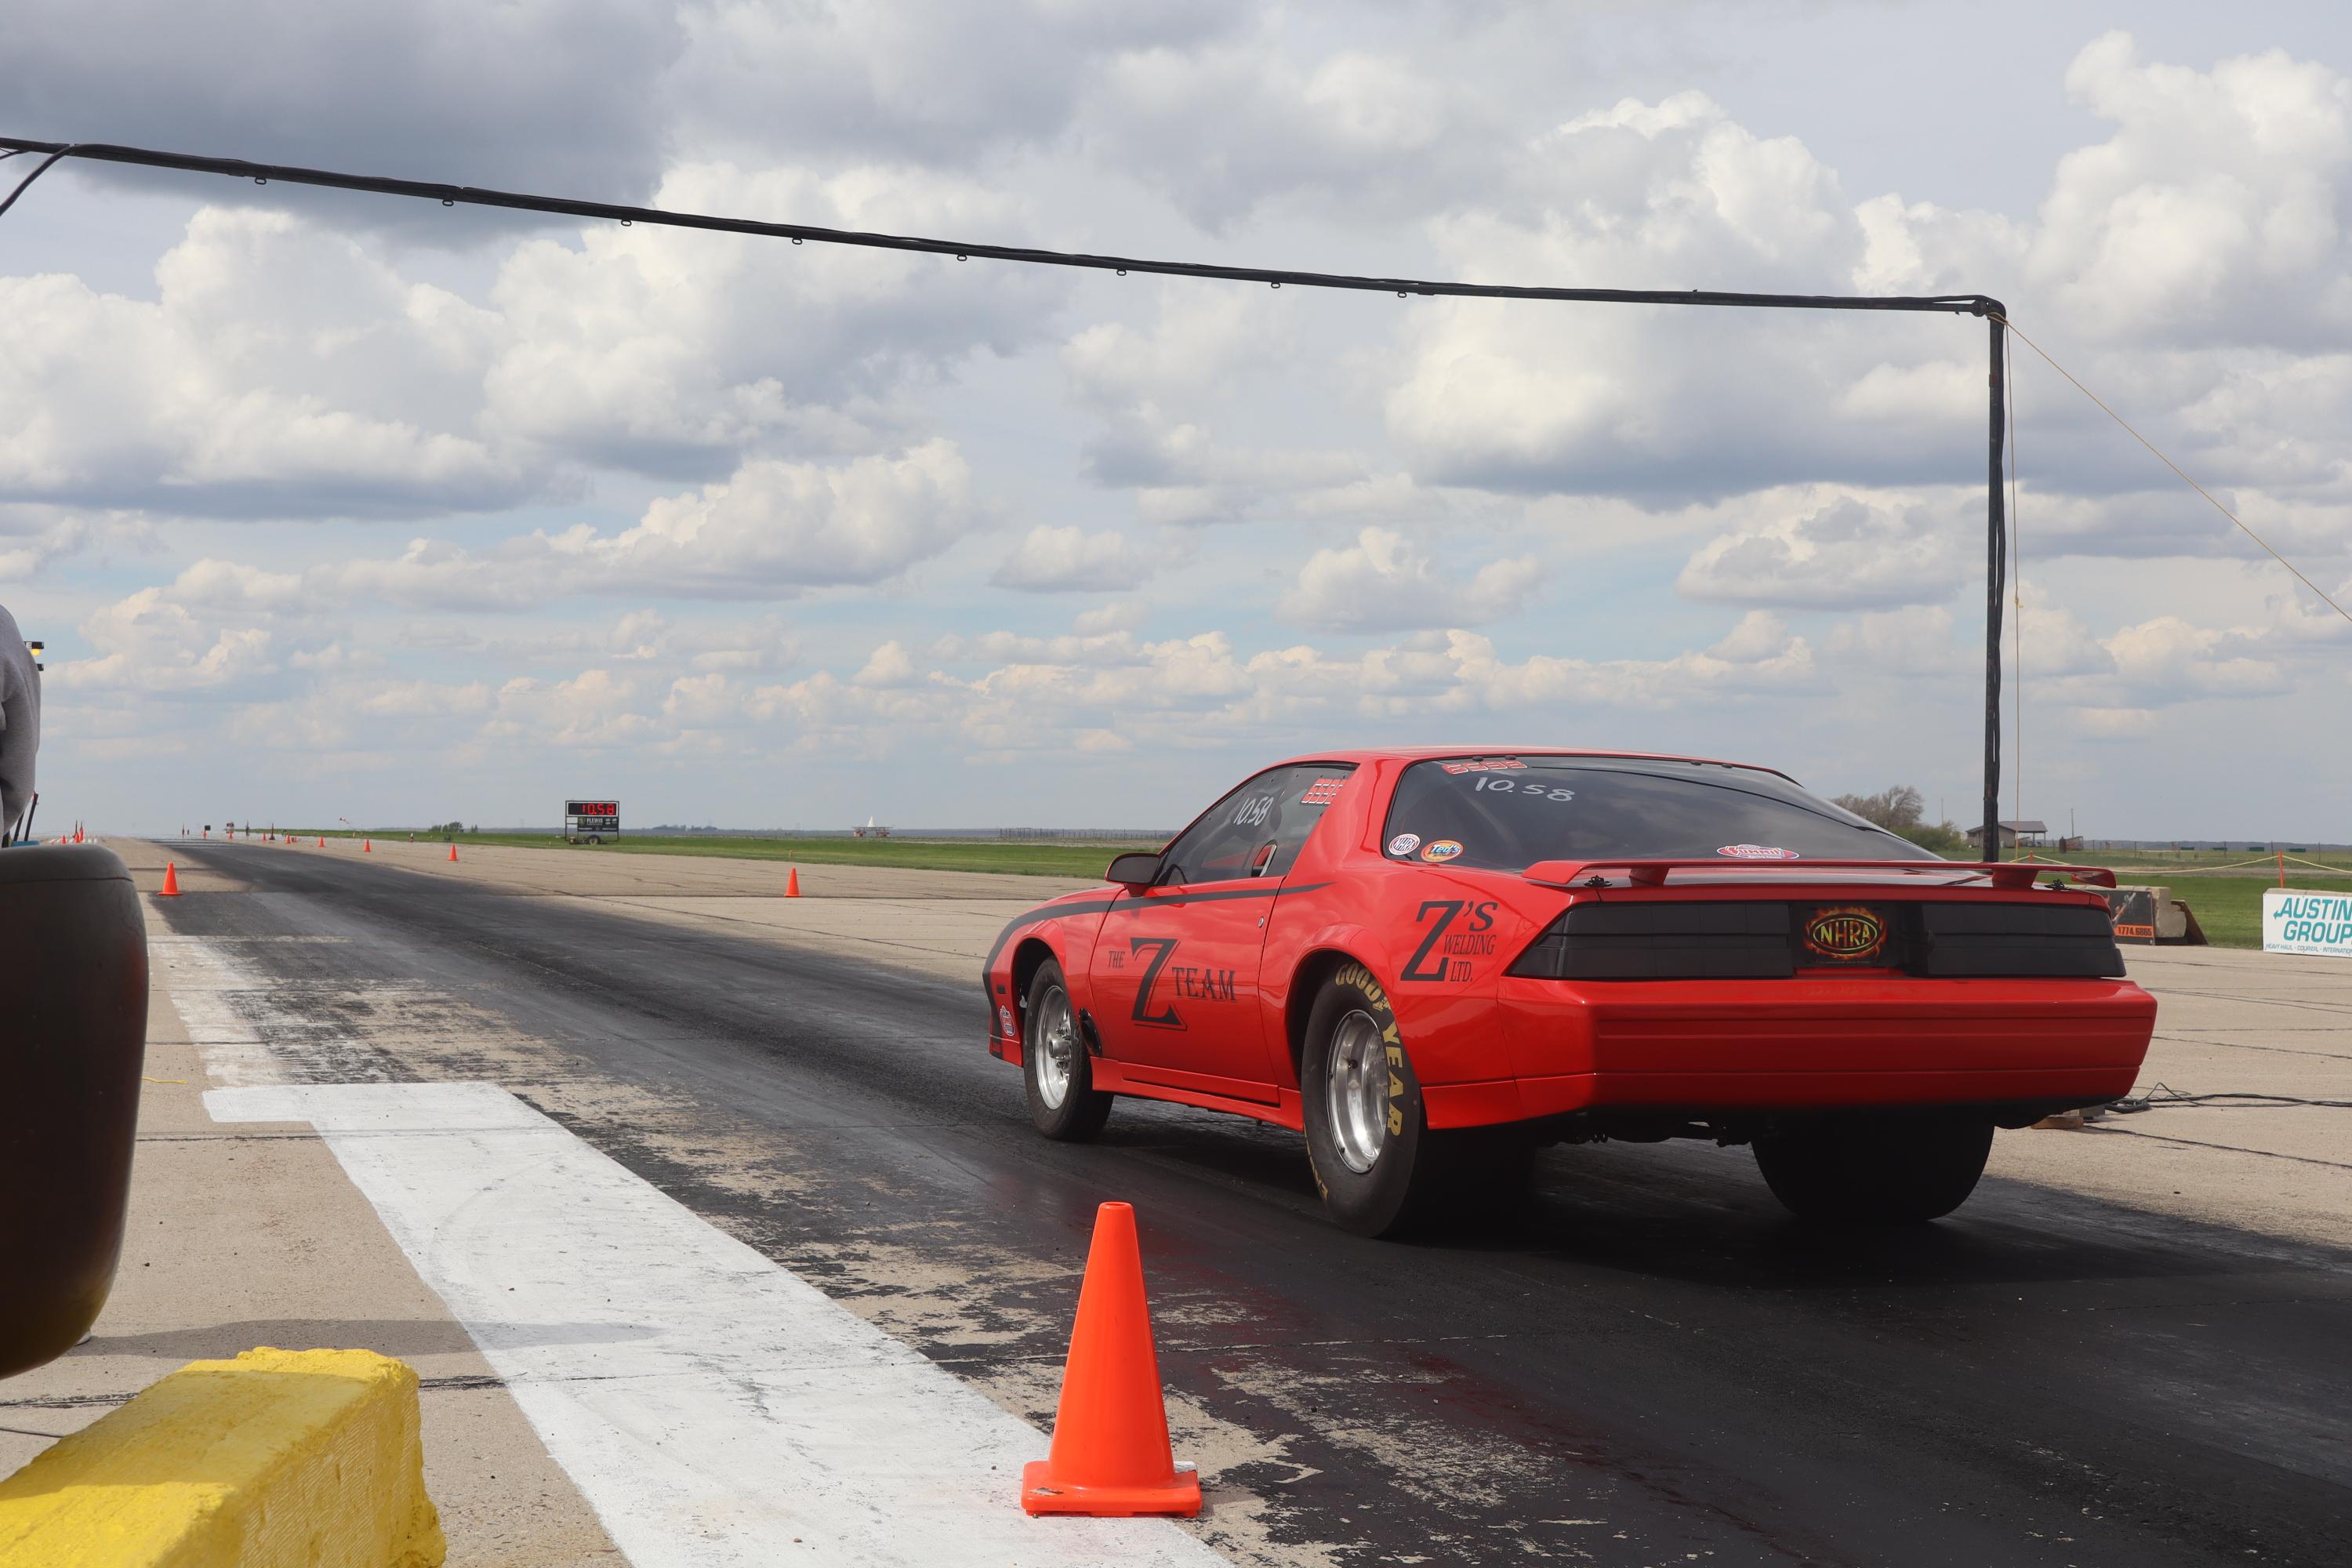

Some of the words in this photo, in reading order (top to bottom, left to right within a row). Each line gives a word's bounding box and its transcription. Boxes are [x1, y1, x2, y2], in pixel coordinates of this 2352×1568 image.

[1475, 776, 1576, 802] 10.58
[583, 803, 615, 815] 10.58
[1233, 796, 1274, 826] 10.58
[1394, 837, 1415, 851] NHRA
[1431, 844, 1461, 854] Ted's
[2278, 897, 2352, 920] AUSTIN
[1400, 899, 1499, 982] Z'S
[1820, 921, 1872, 948] NHRA
[2283, 920, 2352, 944] GROUP
[1443, 935, 1497, 956] WELDING
[1449, 960, 1473, 982] LTD.
[1108, 950, 1124, 969] THE
[1130, 937, 1188, 1031] Z
[1171, 966, 1236, 1002] TEAM
